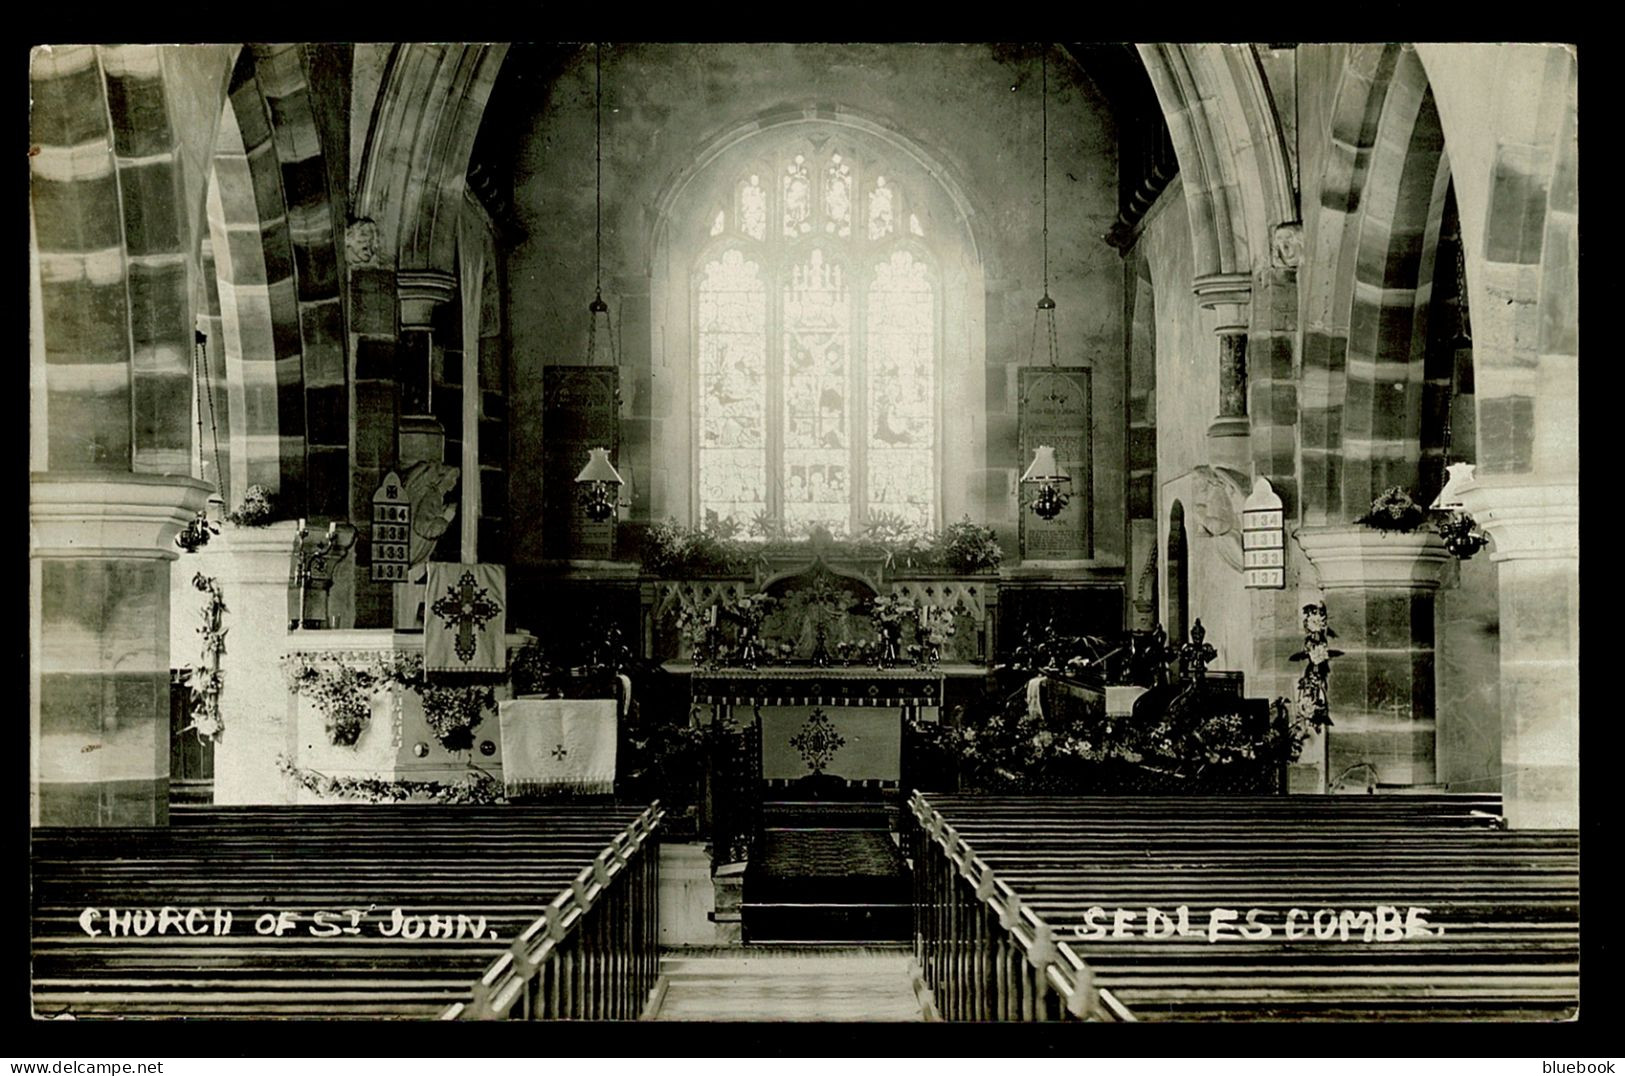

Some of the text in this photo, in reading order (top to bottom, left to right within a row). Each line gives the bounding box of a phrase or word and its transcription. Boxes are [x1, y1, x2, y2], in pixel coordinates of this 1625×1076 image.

[1251, 514, 1278, 527] 134
[1251, 533, 1278, 546] 131
[378, 545, 405, 560] 133
[1252, 553, 1279, 565] 133
[377, 565, 404, 579] 137
[1252, 572, 1279, 584] 137
